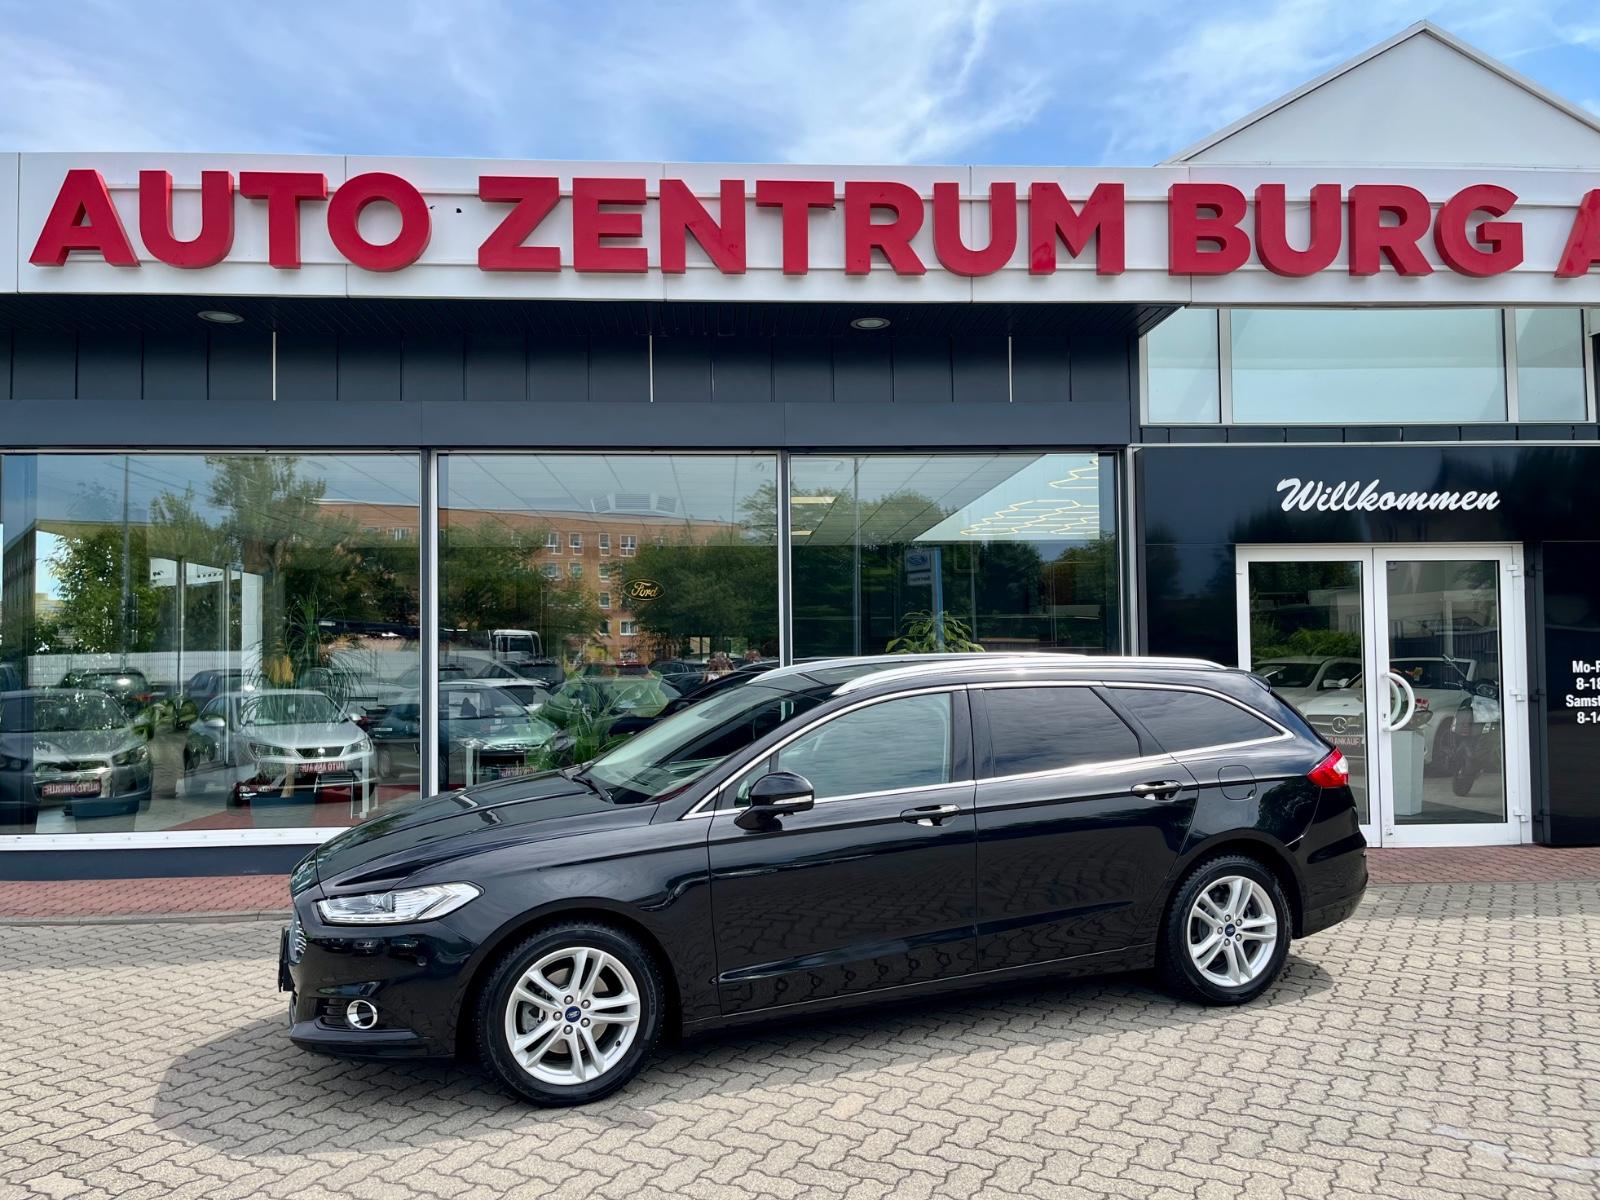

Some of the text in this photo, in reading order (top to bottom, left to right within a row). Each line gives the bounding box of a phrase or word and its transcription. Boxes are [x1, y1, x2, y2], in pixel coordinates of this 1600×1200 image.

[29, 169, 432, 272] AUTO
[478, 176, 1125, 277] ZENTRUM
[1168, 183, 1524, 277] BURG
[1276, 478, 1501, 511] Willkommen
[631, 581, 658, 597] Ford
